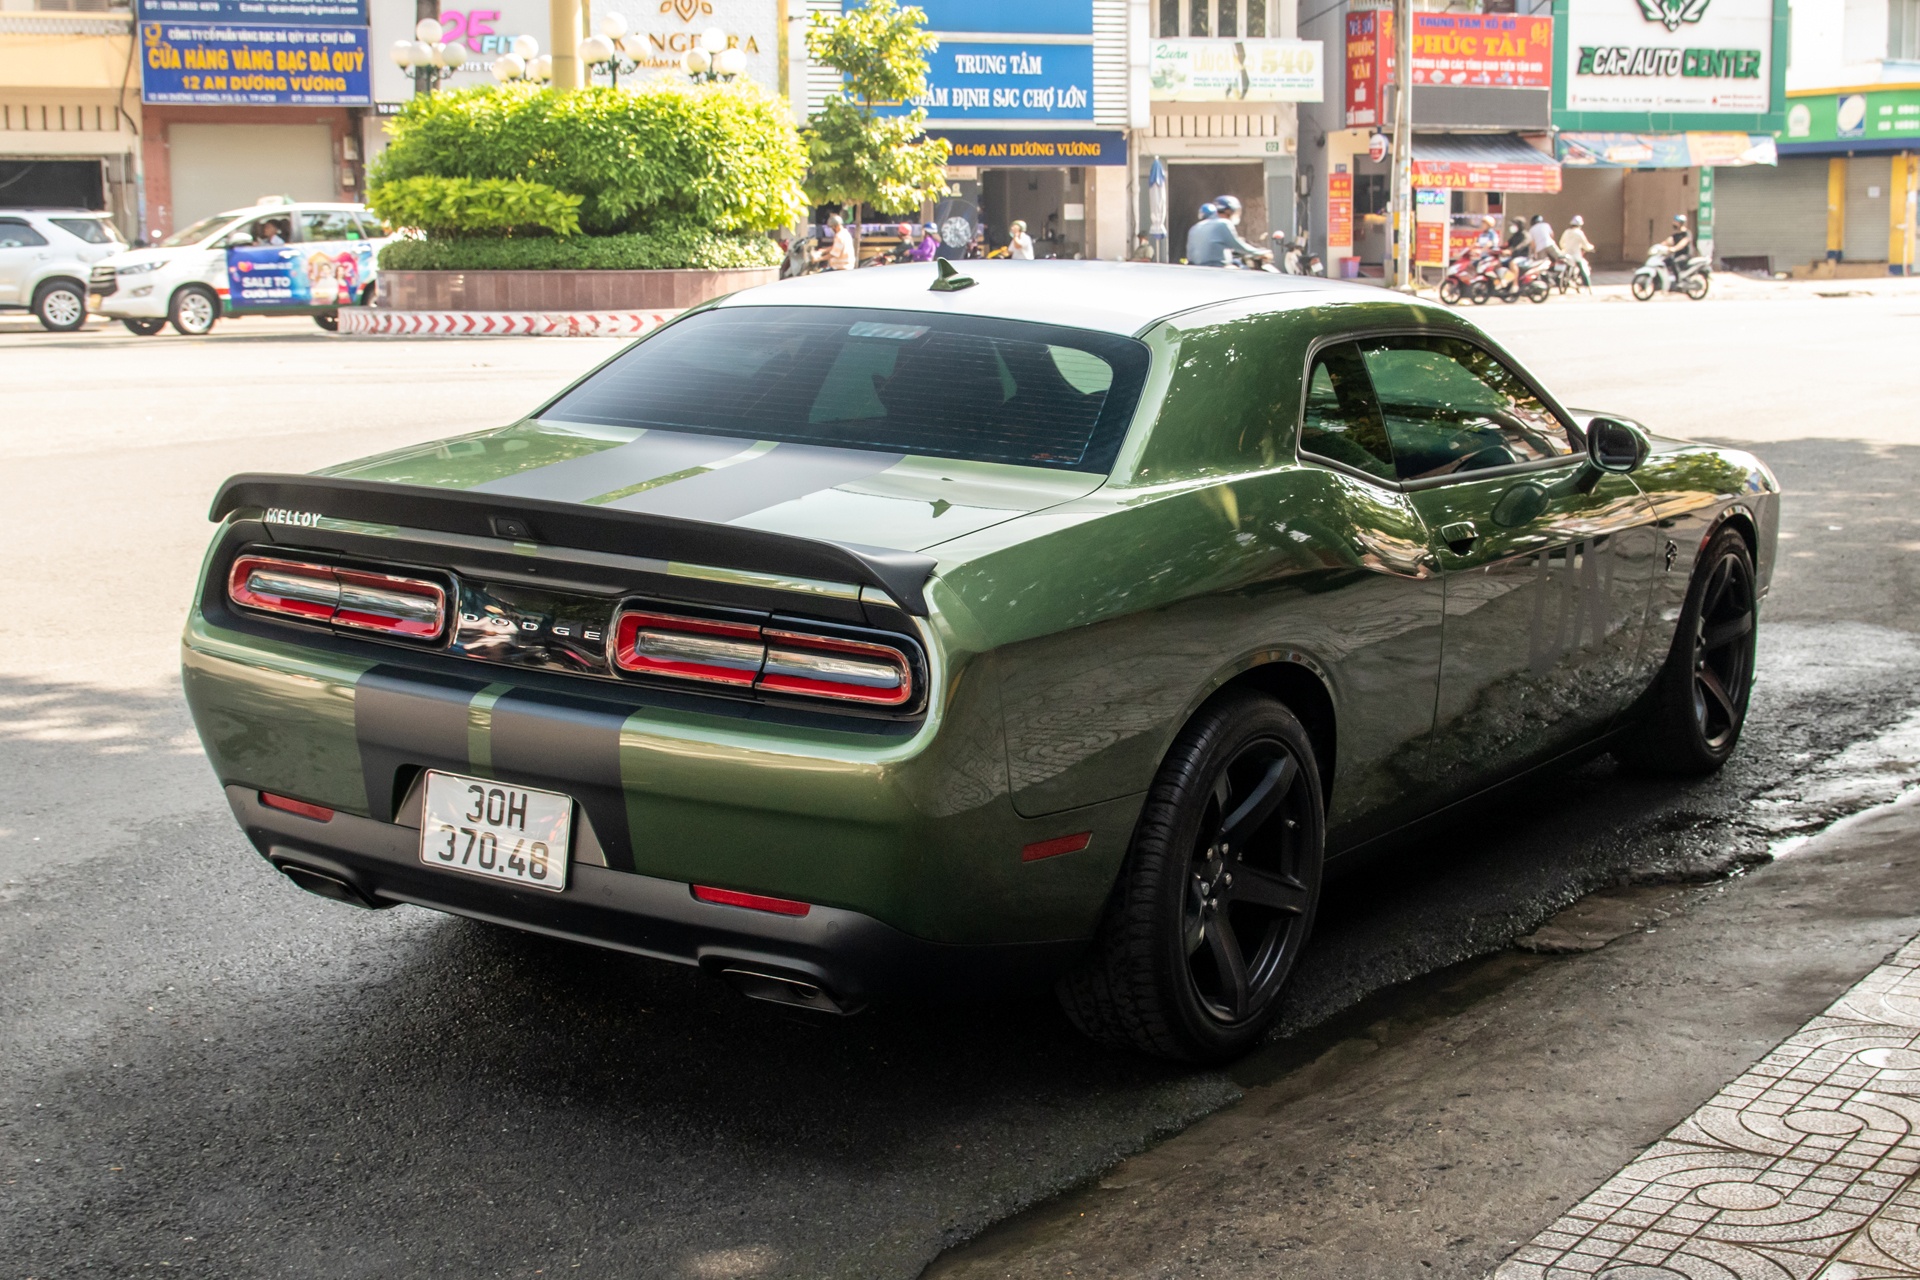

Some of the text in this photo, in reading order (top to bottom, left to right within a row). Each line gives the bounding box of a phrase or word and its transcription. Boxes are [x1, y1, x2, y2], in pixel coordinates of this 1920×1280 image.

[1155, 44, 1189, 59] Quán
[1412, 29, 1527, 57] PHÚC TÀI
[184, 43, 229, 70] HÀNG
[231, 44, 274, 71] VÀNG
[276, 50, 307, 75] BẠC
[309, 46, 331, 72] ĐÁ
[955, 51, 1042, 75] TRUNG TÂM
[1261, 48, 1314, 75] 540
[182, 73, 347, 92] 12 AN DƯƠNG VƯƠNG
[952, 88, 989, 110] ĐỊNH
[993, 89, 1020, 108] SJC
[1023, 86, 1055, 112] CHỢ
[1057, 85, 1087, 108] LỚN
[988, 143, 1007, 156] AN
[1010, 141, 1054, 156] DƯƠNG
[1057, 142, 1100, 156] VƯƠNG
[1267, 142, 1279, 152] 02
[1445, 172, 1466, 187] TÀI
[242, 276, 291, 288] SALE TO
[463, 612, 601, 641] DODGE
[466, 784, 528, 832] 30H
[438, 824, 549, 880] 370.48
